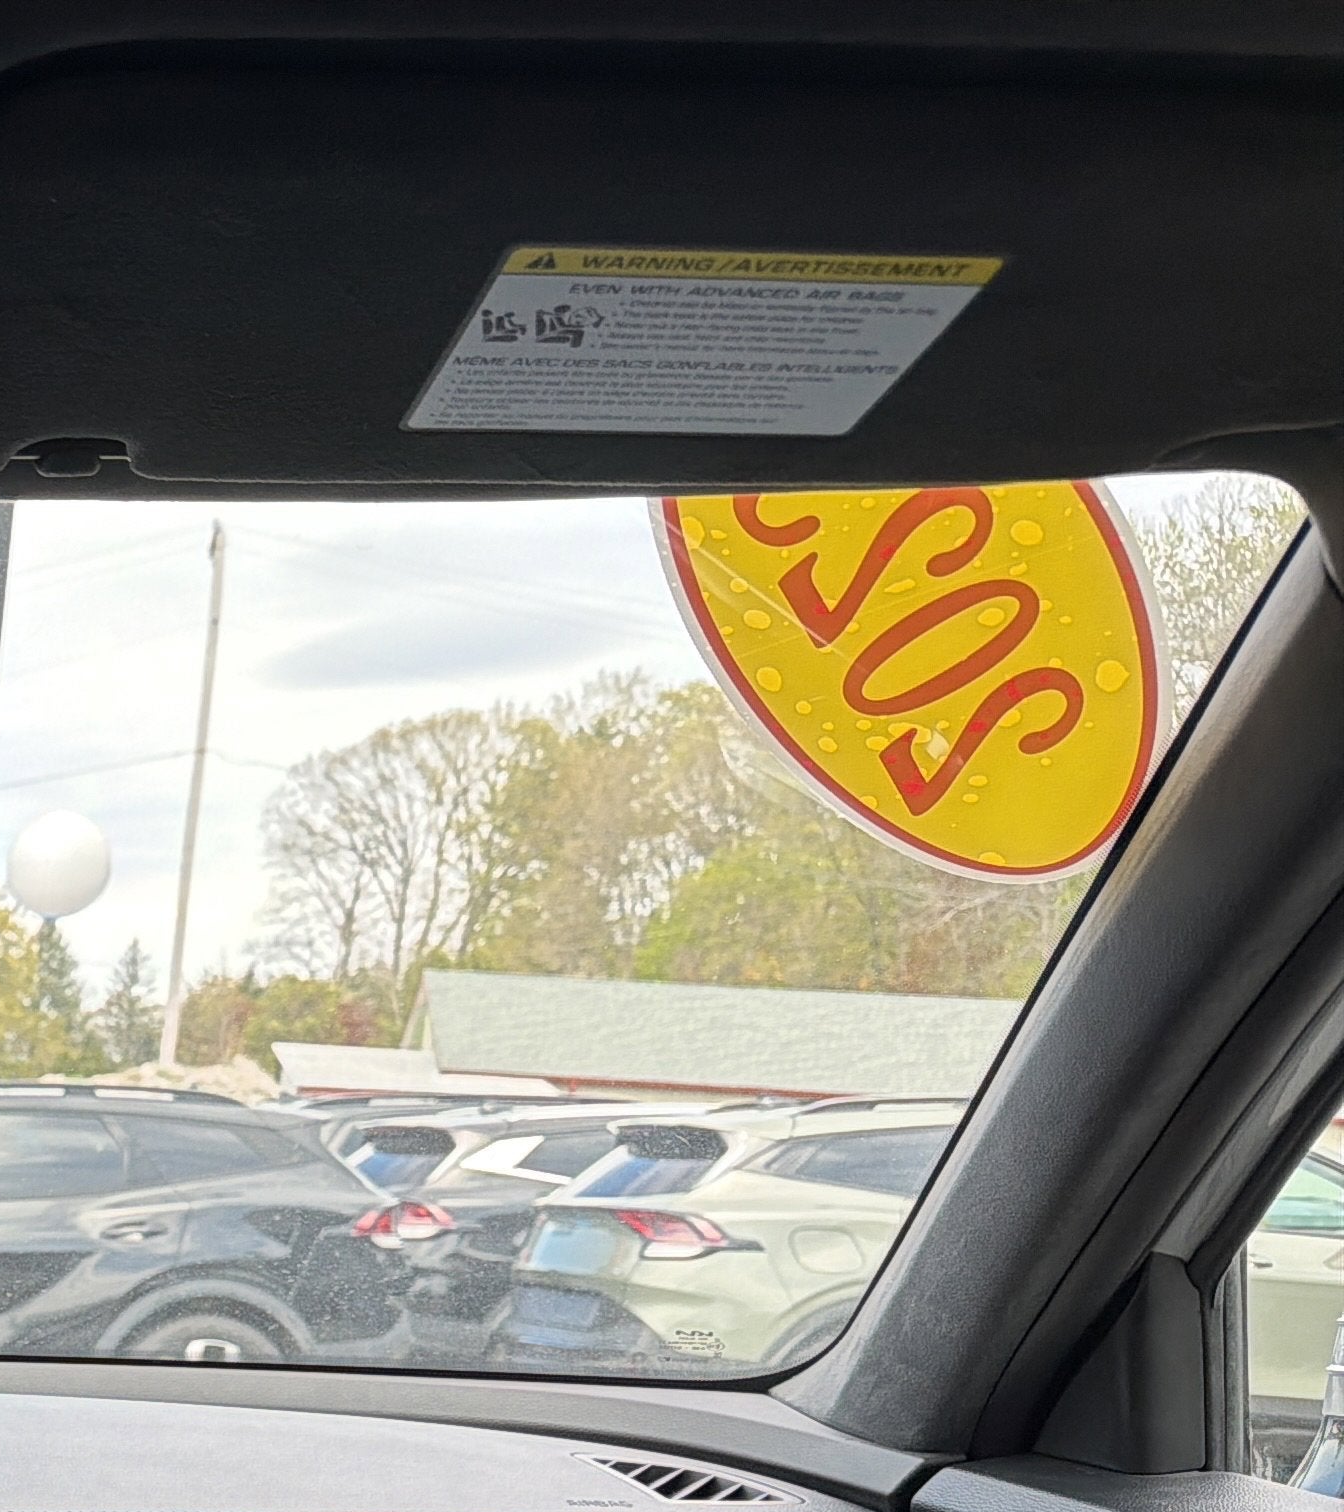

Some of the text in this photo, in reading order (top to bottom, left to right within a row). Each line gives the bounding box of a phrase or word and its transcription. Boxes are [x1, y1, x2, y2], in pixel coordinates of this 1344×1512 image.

[568, 283, 622, 295] EVEN
[630, 284, 682, 296] WITH
[687, 286, 800, 299] ADVANCED
[806, 289, 842, 300] AIR
[511, 356, 562, 368] AVEC
[563, 357, 600, 369] DES
[602, 358, 653, 370] SACS
[655, 359, 774, 372] GONFLABLES
